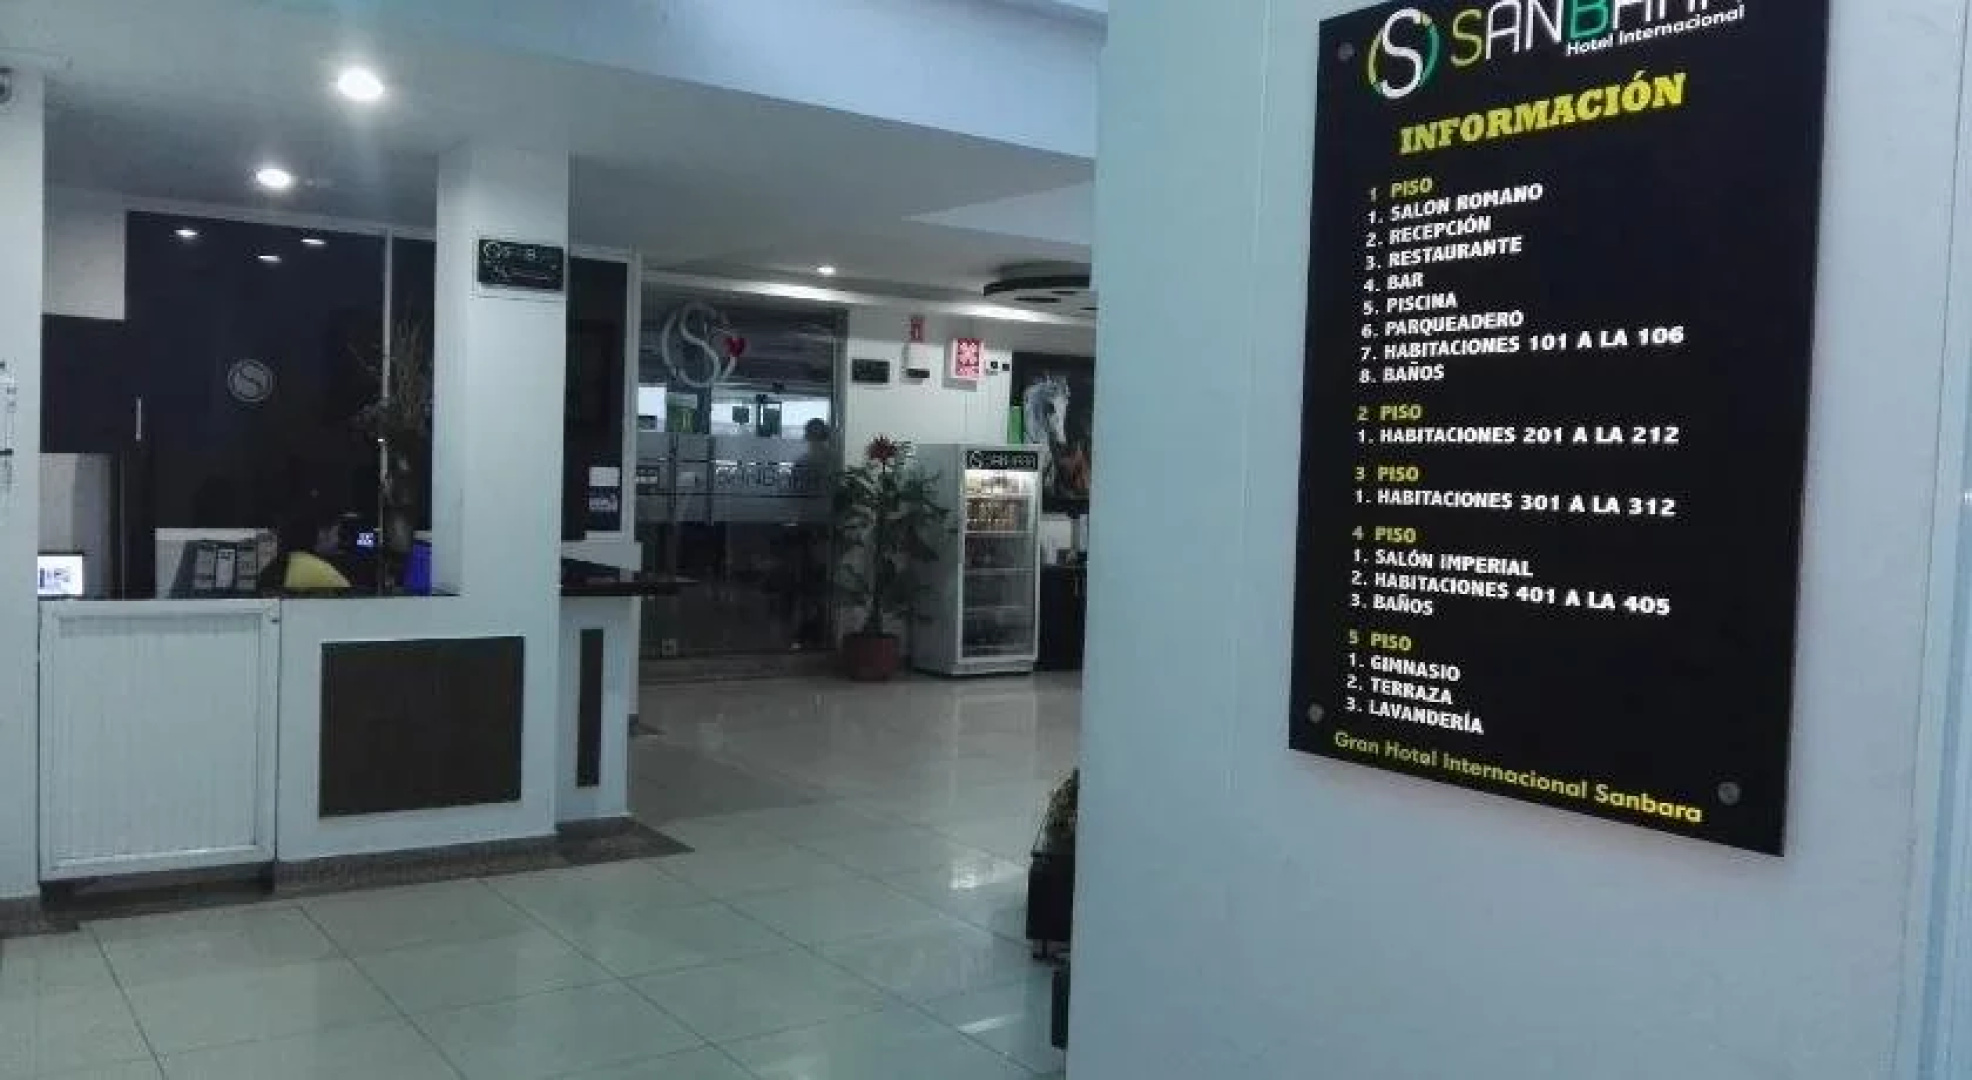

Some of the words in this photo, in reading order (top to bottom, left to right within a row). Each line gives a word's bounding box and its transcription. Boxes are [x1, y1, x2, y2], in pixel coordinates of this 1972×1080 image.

[1566, 32, 1614, 57] Hotel
[1619, 4, 1745, 45] Internacional
[1400, 69, 1687, 154] INFORMACIÓN
[1367, 210, 1384, 224] 1.
[1455, 182, 1544, 212] ROMANO
[1370, 187, 1377, 201] 1
[1391, 177, 1433, 198] PISO
[1365, 231, 1384, 248] 2.
[1389, 213, 1492, 245] RECEPCIÓN
[1365, 255, 1382, 271] 3.
[1387, 234, 1523, 268] RESTAURANTE
[1363, 278, 1381, 292] 4.
[1386, 271, 1424, 291] BAR
[1363, 299, 1379, 316] 5.
[1386, 291, 1459, 313] PISCINA
[1361, 323, 1379, 339] 6.
[1384, 310, 1525, 337] PARQUEADERO
[1361, 346, 1377, 362] 7.
[1384, 335, 1520, 360] HABITACIONES
[1529, 332, 1567, 351] 101
[1576, 330, 1593, 350] A
[1598, 328, 1628, 349] LA
[1638, 325, 1685, 346] 106
[1359, 368, 1377, 384] 8.
[1382, 361, 1445, 383] BAÑOS
[1357, 405, 1369, 421] 2
[1379, 403, 1422, 421] PISO
[1358, 428, 1374, 444] 1.
[1379, 426, 1517, 445] HABITACIONES
[1522, 426, 1562, 445] 201
[1572, 426, 1588, 444] A
[1593, 426, 1625, 445] LA
[1630, 426, 1680, 445] 212
[1355, 466, 1365, 481] 3
[1377, 466, 1419, 482] PISO
[1356, 488, 1372, 504] 1.
[1377, 488, 1513, 511] HABITACIONES
[1520, 494, 1560, 513] 301
[1567, 494, 1586, 513] A
[1591, 494, 1621, 515] LA
[1628, 497, 1677, 518] 312
[1351, 525, 1364, 541] 4
[1375, 525, 1417, 544] PISO
[1353, 548, 1369, 563] 1.
[1375, 548, 1433, 569] SALÓN
[1439, 553, 1534, 578] IMPERIAL
[1350, 594, 1368, 609] 3.
[1373, 593, 1433, 616] BAÑOS
[1351, 569, 1368, 586] 2.
[1374, 572, 1510, 600] HABITACIONES
[1515, 586, 1555, 605] 401
[1564, 588, 1581, 607] A
[1586, 590, 1616, 611] LA
[1621, 595, 1671, 616] 405
[1349, 629, 1360, 644] 5
[1370, 632, 1412, 652] PISO
[1349, 652, 1365, 668] 1.
[1370, 654, 1461, 682] GIMNASIO
[1346, 673, 1363, 691] 2.
[1370, 675, 1454, 705] TERRAZA
[1345, 696, 1363, 712] 3.
[1368, 700, 1485, 735] LAVANDERÍA
[1335, 731, 1379, 755] Gran
[1384, 741, 1437, 766] Hotel
[1443, 753, 1588, 799] Internacional
[1593, 783, 1703, 823] Sanbara
